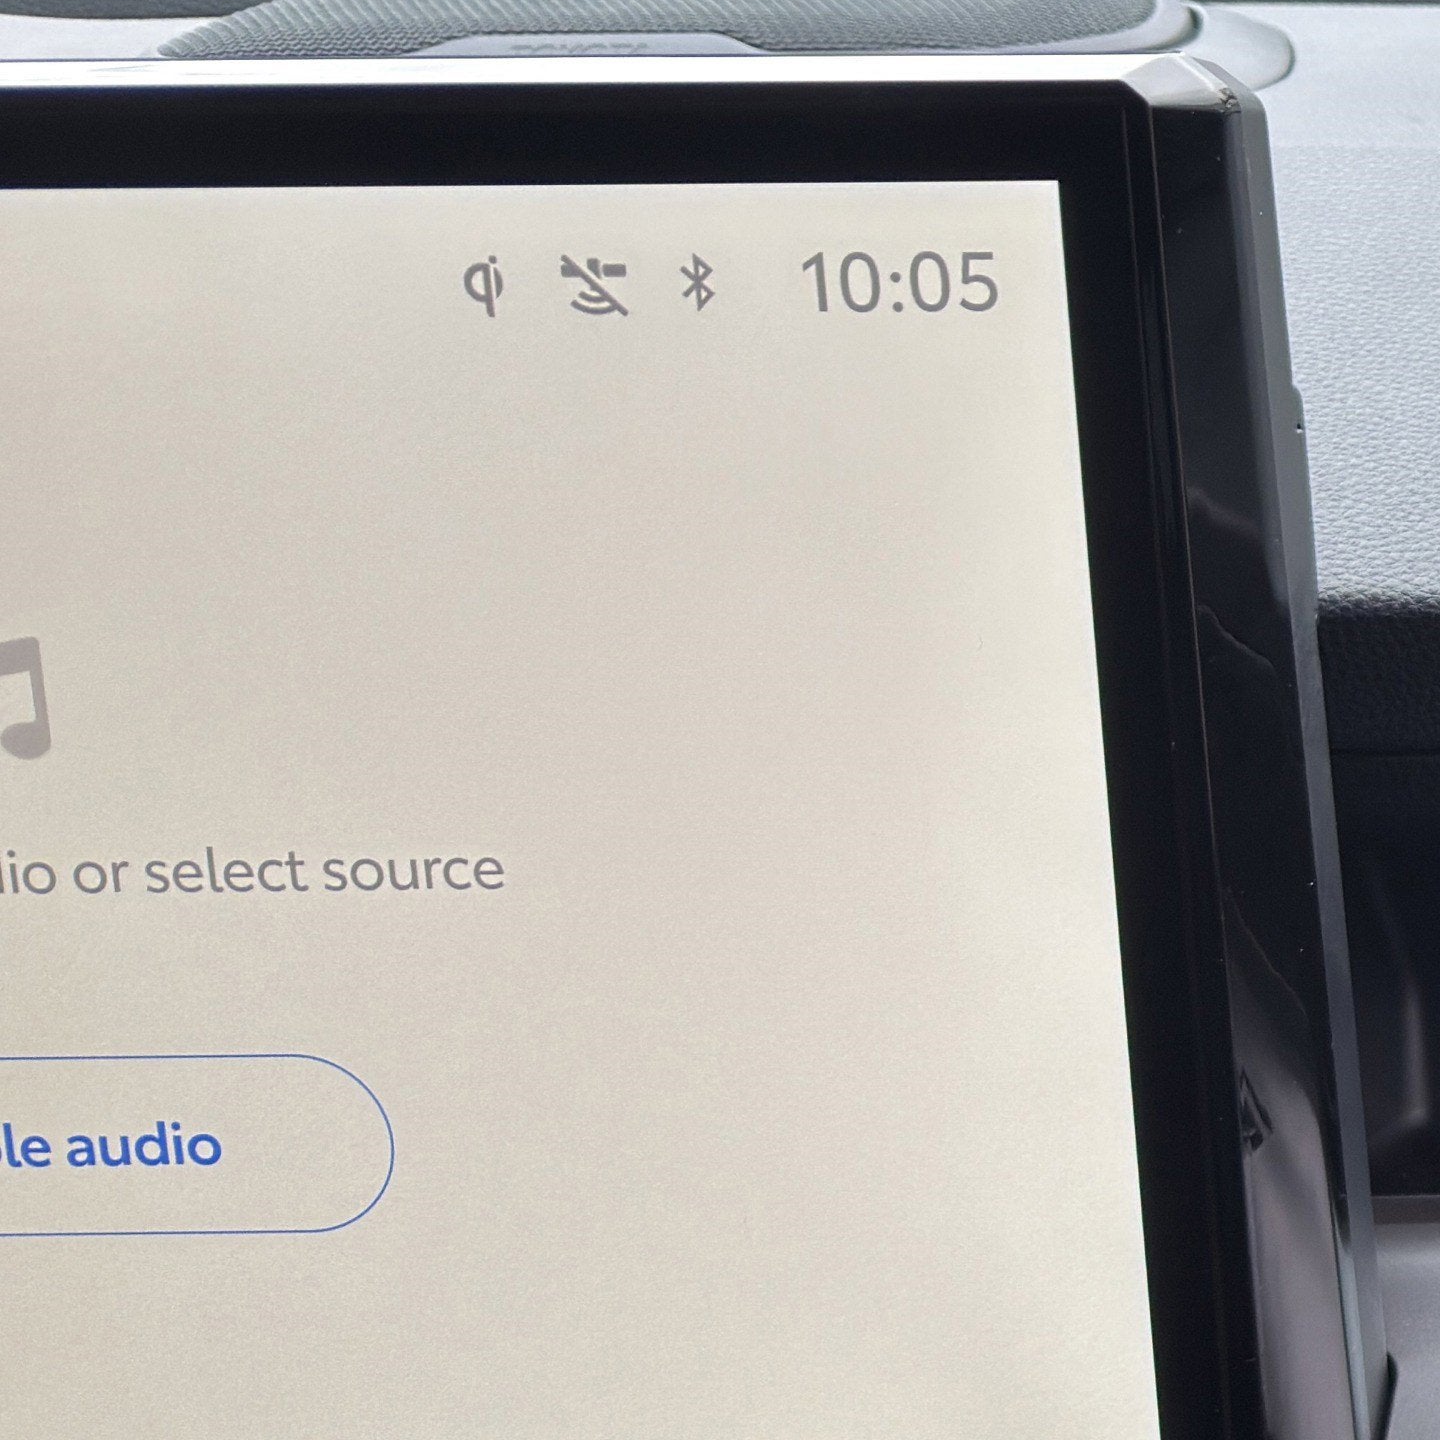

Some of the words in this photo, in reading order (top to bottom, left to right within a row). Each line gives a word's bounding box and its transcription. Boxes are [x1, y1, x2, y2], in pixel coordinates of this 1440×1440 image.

[802, 250, 999, 313] 10:05
[0, 849, 57, 895] io
[73, 859, 129, 894] or
[145, 846, 309, 893] select
[323, 855, 505, 892] source
[66, 1121, 222, 1167] audio
